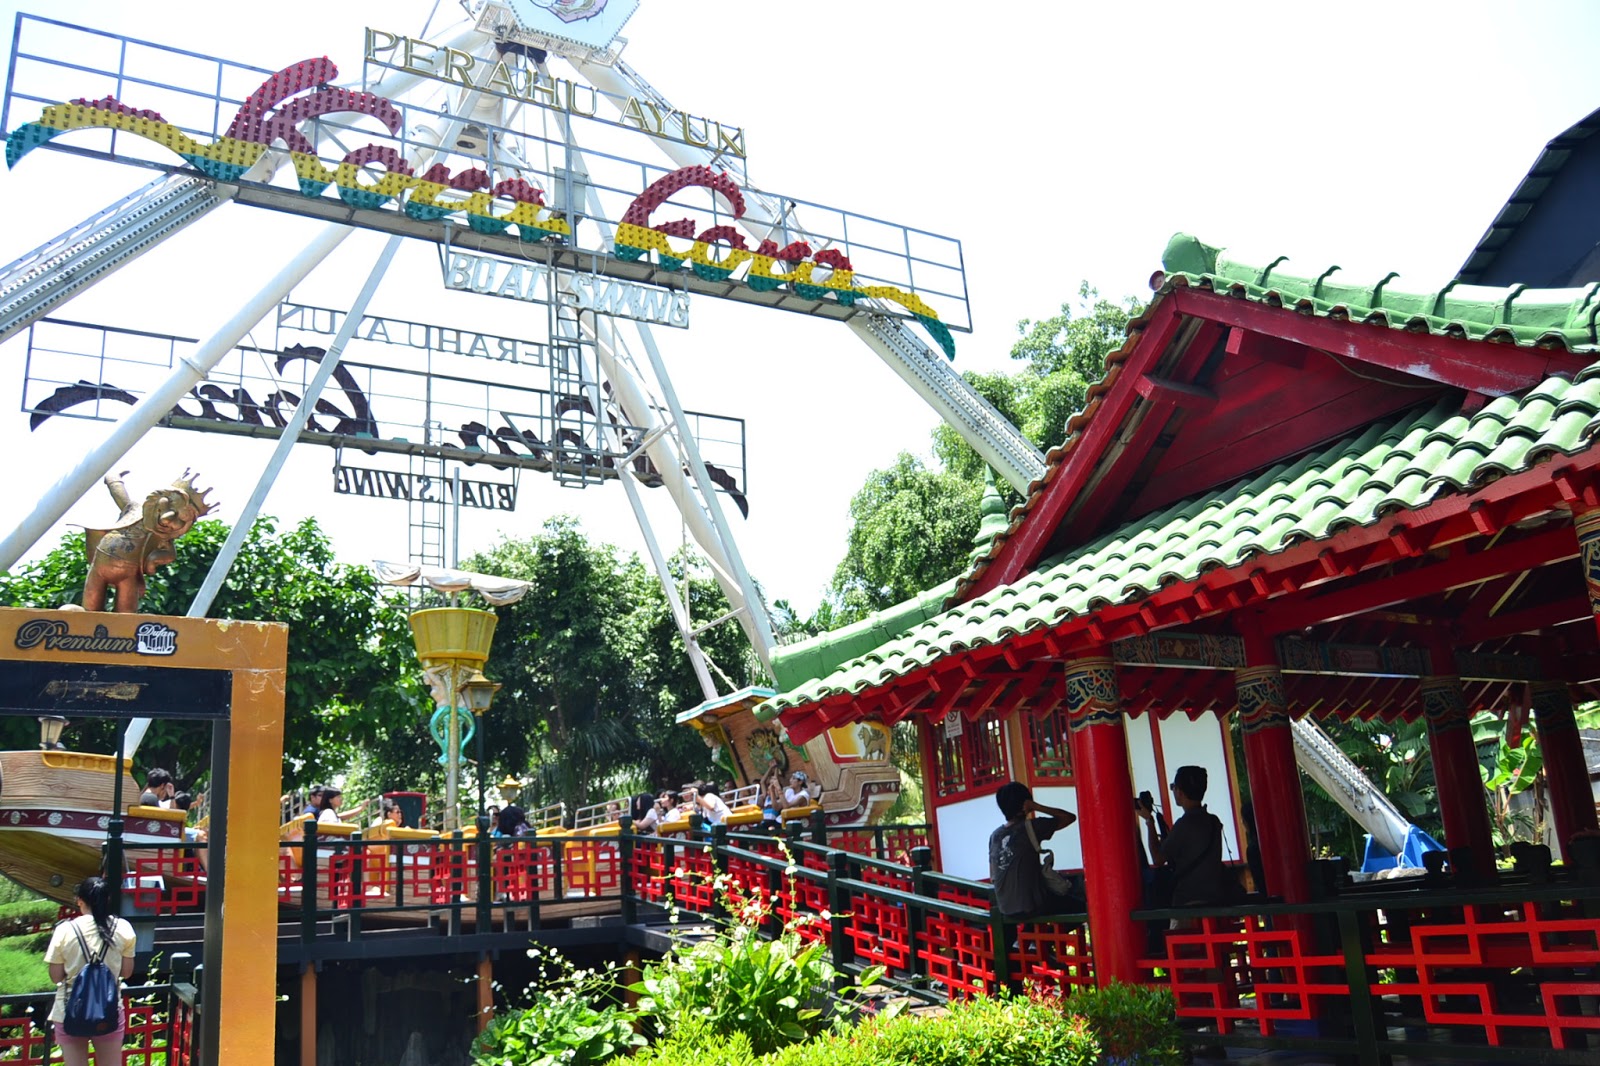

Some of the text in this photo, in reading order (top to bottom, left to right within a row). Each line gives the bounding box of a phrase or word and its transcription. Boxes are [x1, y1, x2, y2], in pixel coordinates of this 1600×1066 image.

[364, 27, 746, 159] PERAHU AYUN
[446, 253, 690, 327] BOAT SWING
[17, 620, 137, 652] Premium
